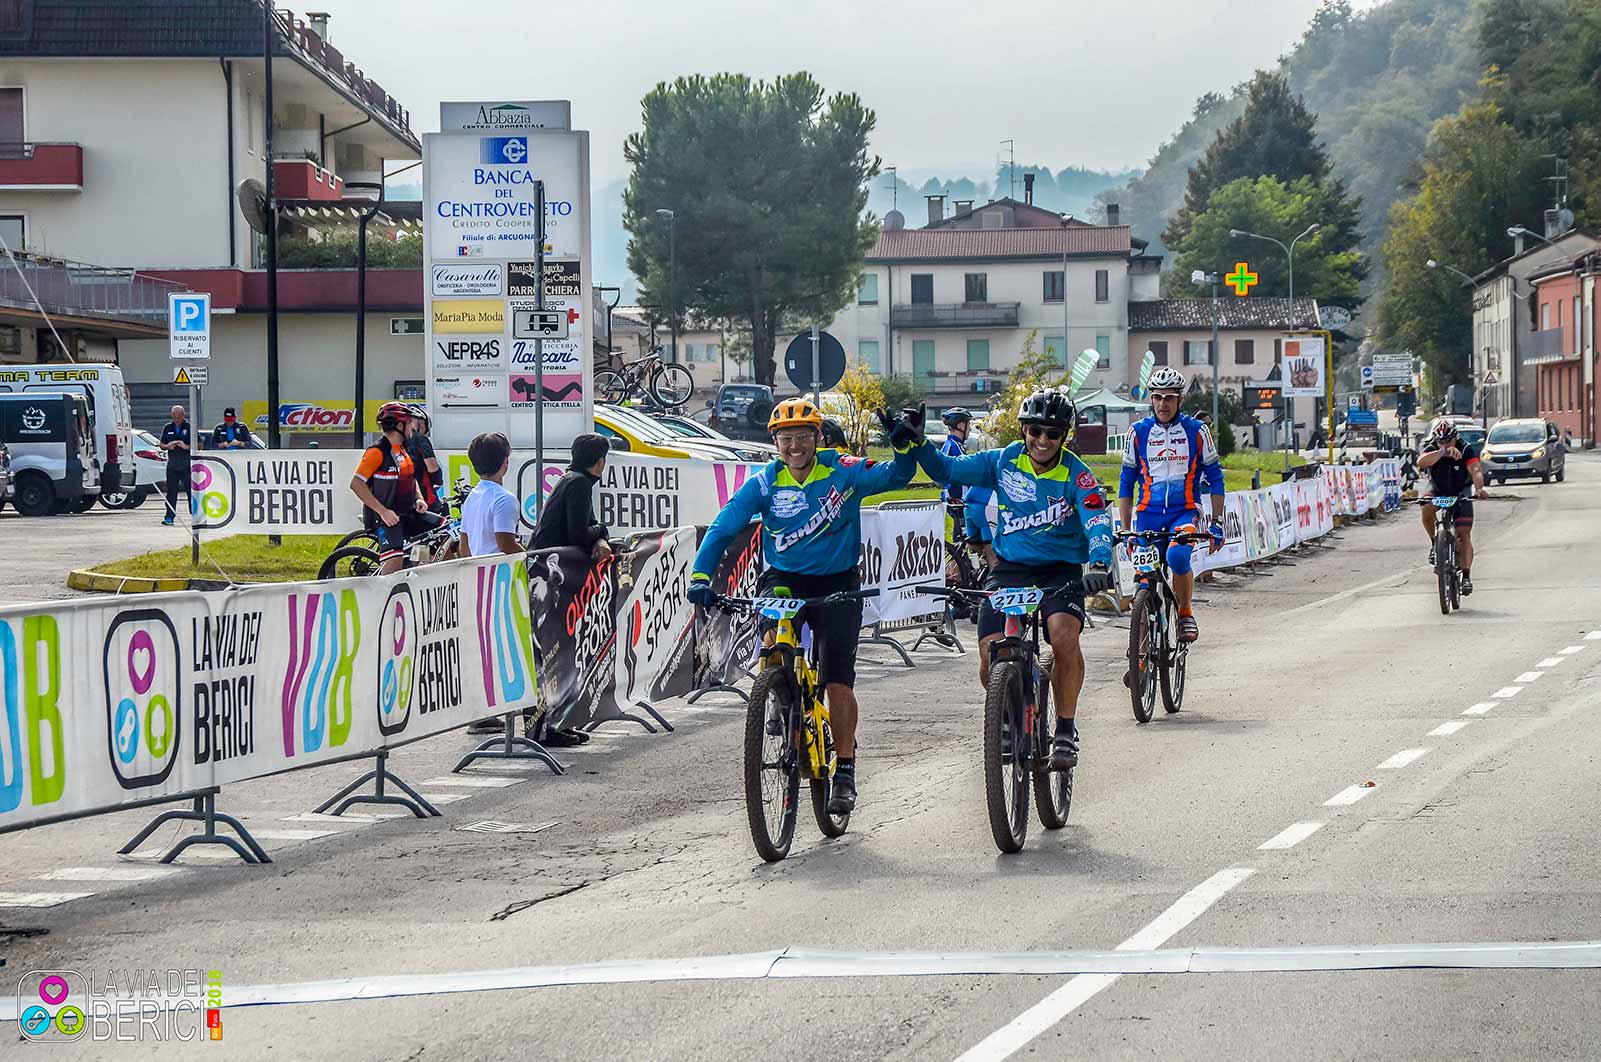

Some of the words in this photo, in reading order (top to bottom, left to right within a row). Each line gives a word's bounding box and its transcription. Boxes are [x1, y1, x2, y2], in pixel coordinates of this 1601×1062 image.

[475, 104, 532, 125] Abbazia
[474, 168, 534, 185] BANCA
[495, 189, 514, 199] DEL
[452, 219, 491, 229] CREDITO
[496, 218, 558, 228] COOPERVO
[498, 233, 548, 241] ARCUGNAO
[510, 285, 580, 295] PARRCHIERA
[181, 302, 199, 328] P
[434, 312, 476, 322] MariaPia
[478, 311, 503, 321] Moda
[436, 339, 500, 360] VEPRAS
[35, 370, 99, 381] TEAM
[247, 461, 266, 485] LA
[272, 461, 302, 485] VIA
[307, 460, 334, 484] DEI
[599, 465, 615, 489] LA
[622, 465, 650, 490] VIA
[654, 467, 679, 491] DEI
[249, 488, 334, 525] BERICI
[600, 492, 679, 528] BERICI
[1133, 551, 1159, 566] 2626
[566, 554, 614, 637] OUTLET
[755, 599, 799, 609] 2710
[994, 592, 1037, 608] 2712
[419, 588, 432, 636] LA
[444, 582, 459, 630] DEI
[646, 560, 688, 663] SPORT
[192, 616, 212, 672] LA
[214, 614, 236, 669] VIA
[239, 611, 262, 667] DEI
[575, 593, 612, 682] SPORT
[282, 588, 361, 758] VDB
[419, 637, 462, 715] BERICI
[194, 675, 255, 765] BERICI
